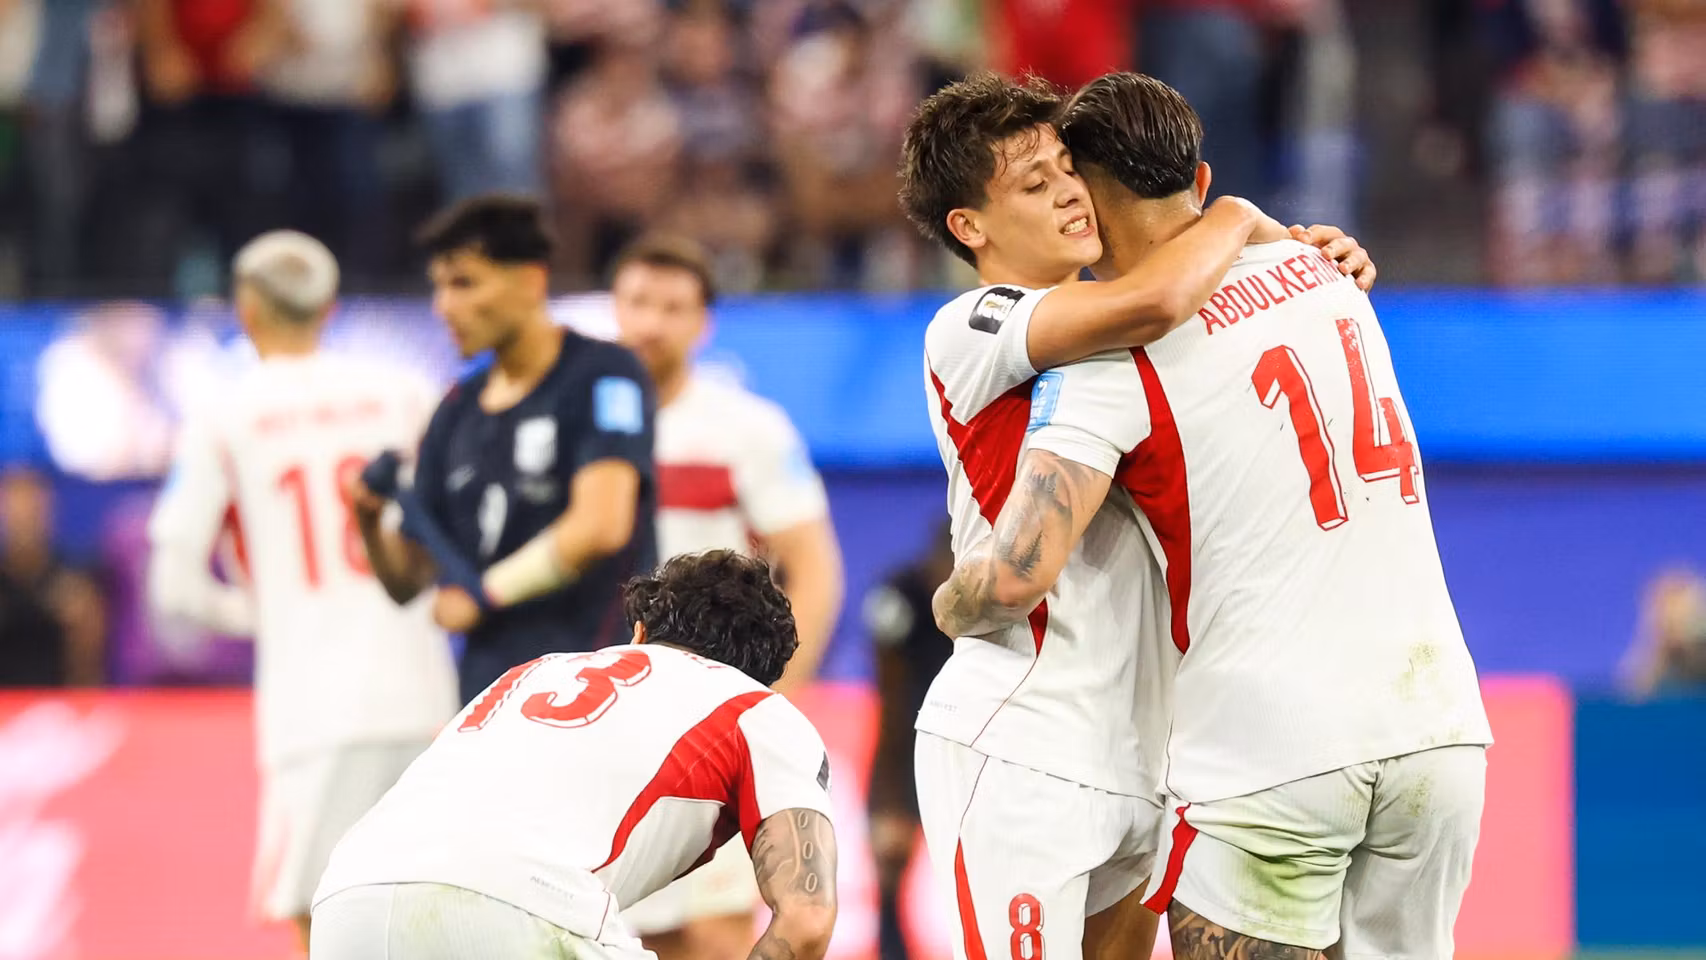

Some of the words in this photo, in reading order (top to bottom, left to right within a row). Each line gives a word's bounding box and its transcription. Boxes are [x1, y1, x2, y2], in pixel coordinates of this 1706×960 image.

[1251, 318, 1420, 531] 14
[457, 649, 653, 732] 13
[1008, 893, 1047, 960] 8
